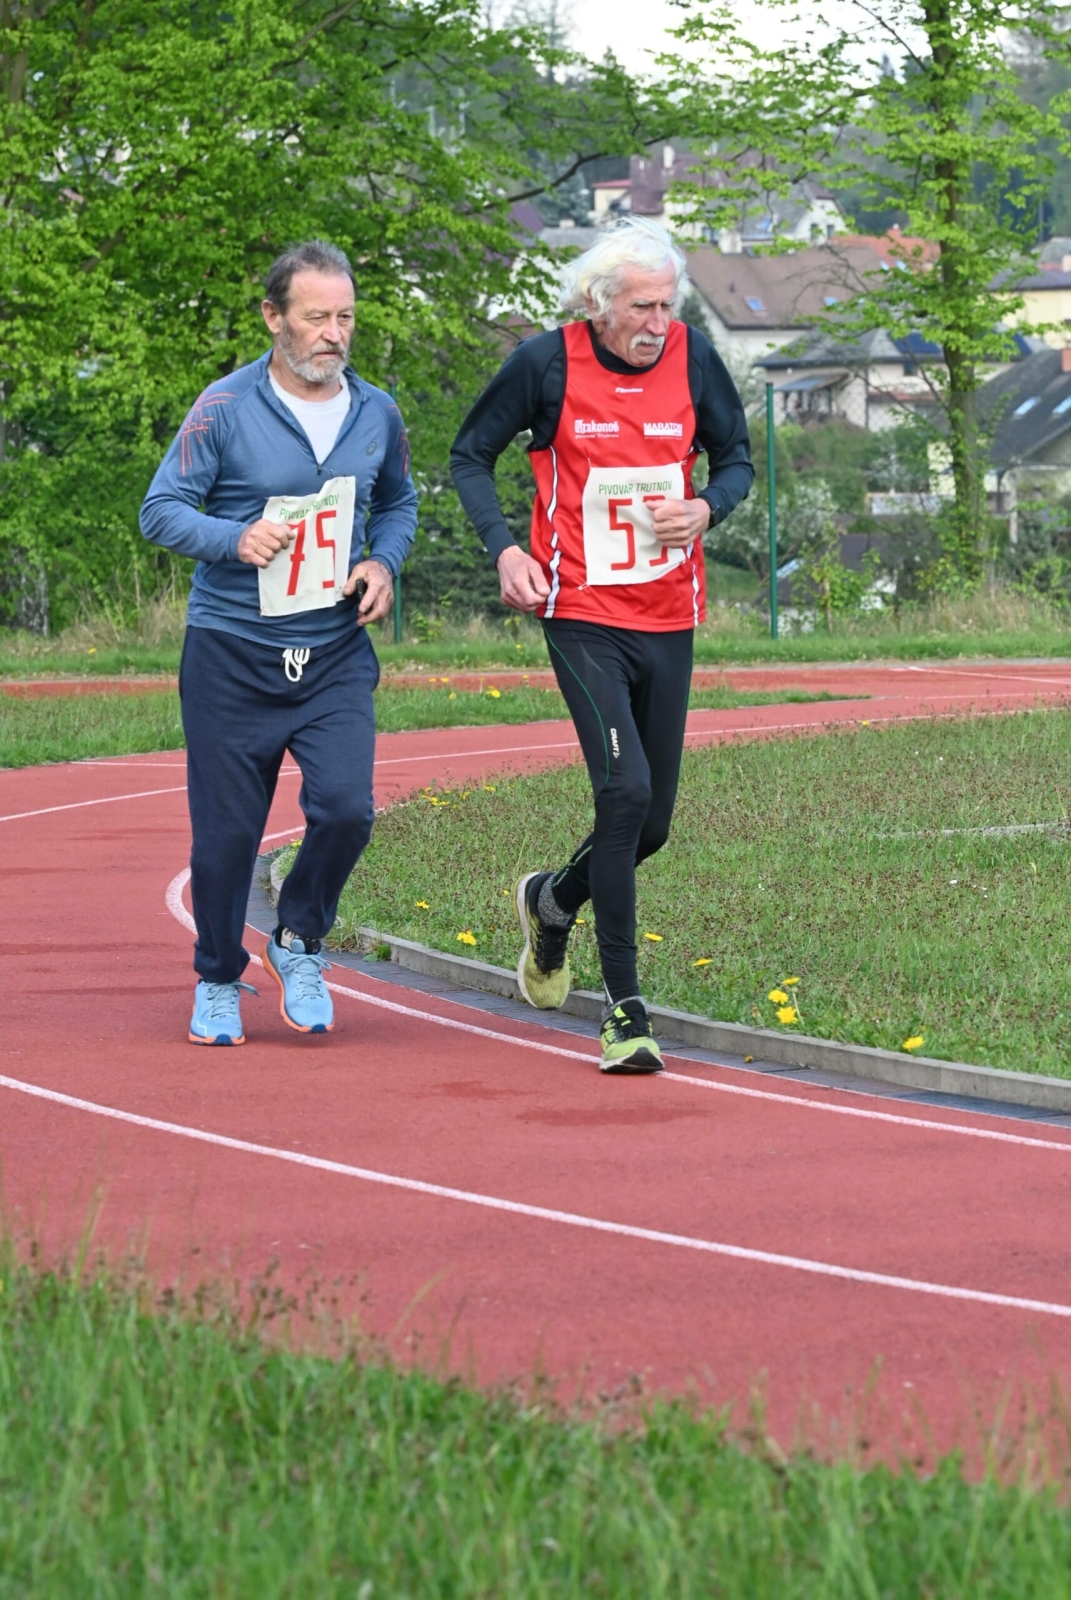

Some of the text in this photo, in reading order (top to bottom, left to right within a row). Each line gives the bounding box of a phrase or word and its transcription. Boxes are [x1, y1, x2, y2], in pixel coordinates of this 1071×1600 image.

[598, 480, 672, 495] PIVOVAR TRUTNOV
[287, 510, 337, 596] 75
[610, 728, 619, 752] CRAFT
